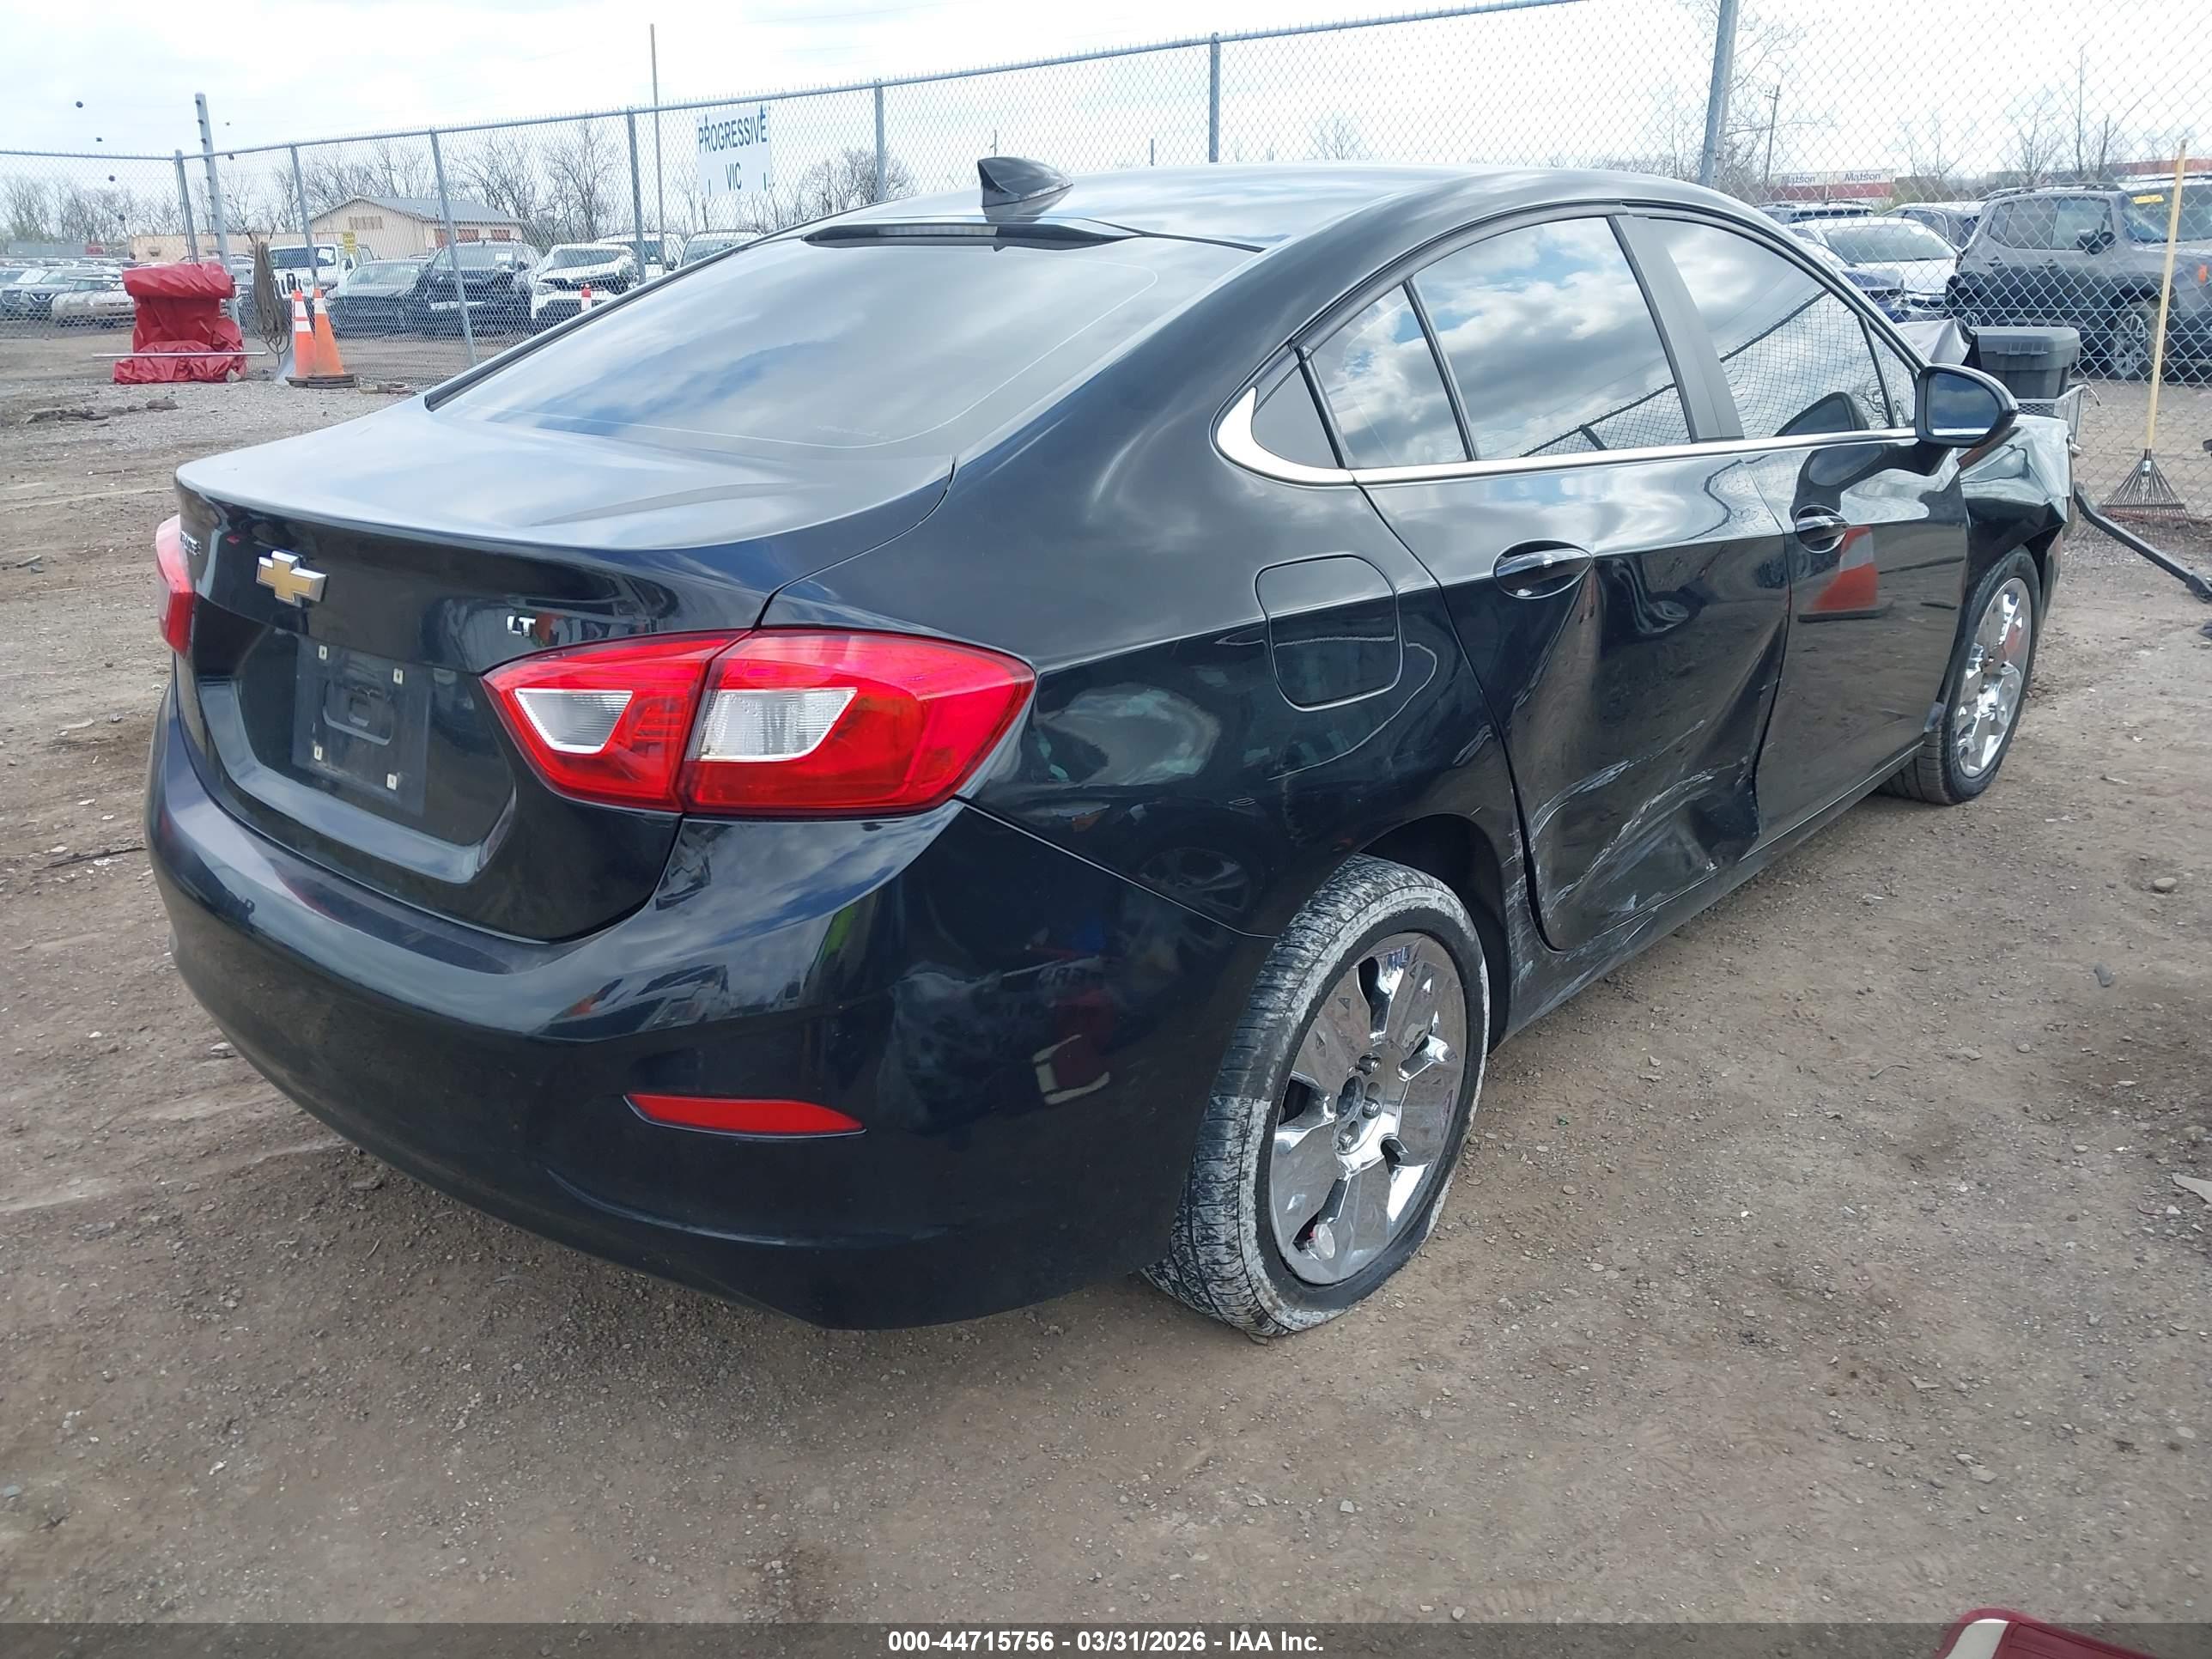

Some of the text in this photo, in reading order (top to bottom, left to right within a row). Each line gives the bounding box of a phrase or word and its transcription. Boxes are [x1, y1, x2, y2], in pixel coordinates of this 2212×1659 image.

[698, 113, 768, 155] PROGRESSIVE
[725, 161, 742, 191] VIC
[1781, 174, 1816, 184] Matson
[1844, 172, 1881, 182] Matson
[507, 615, 537, 636] LT
